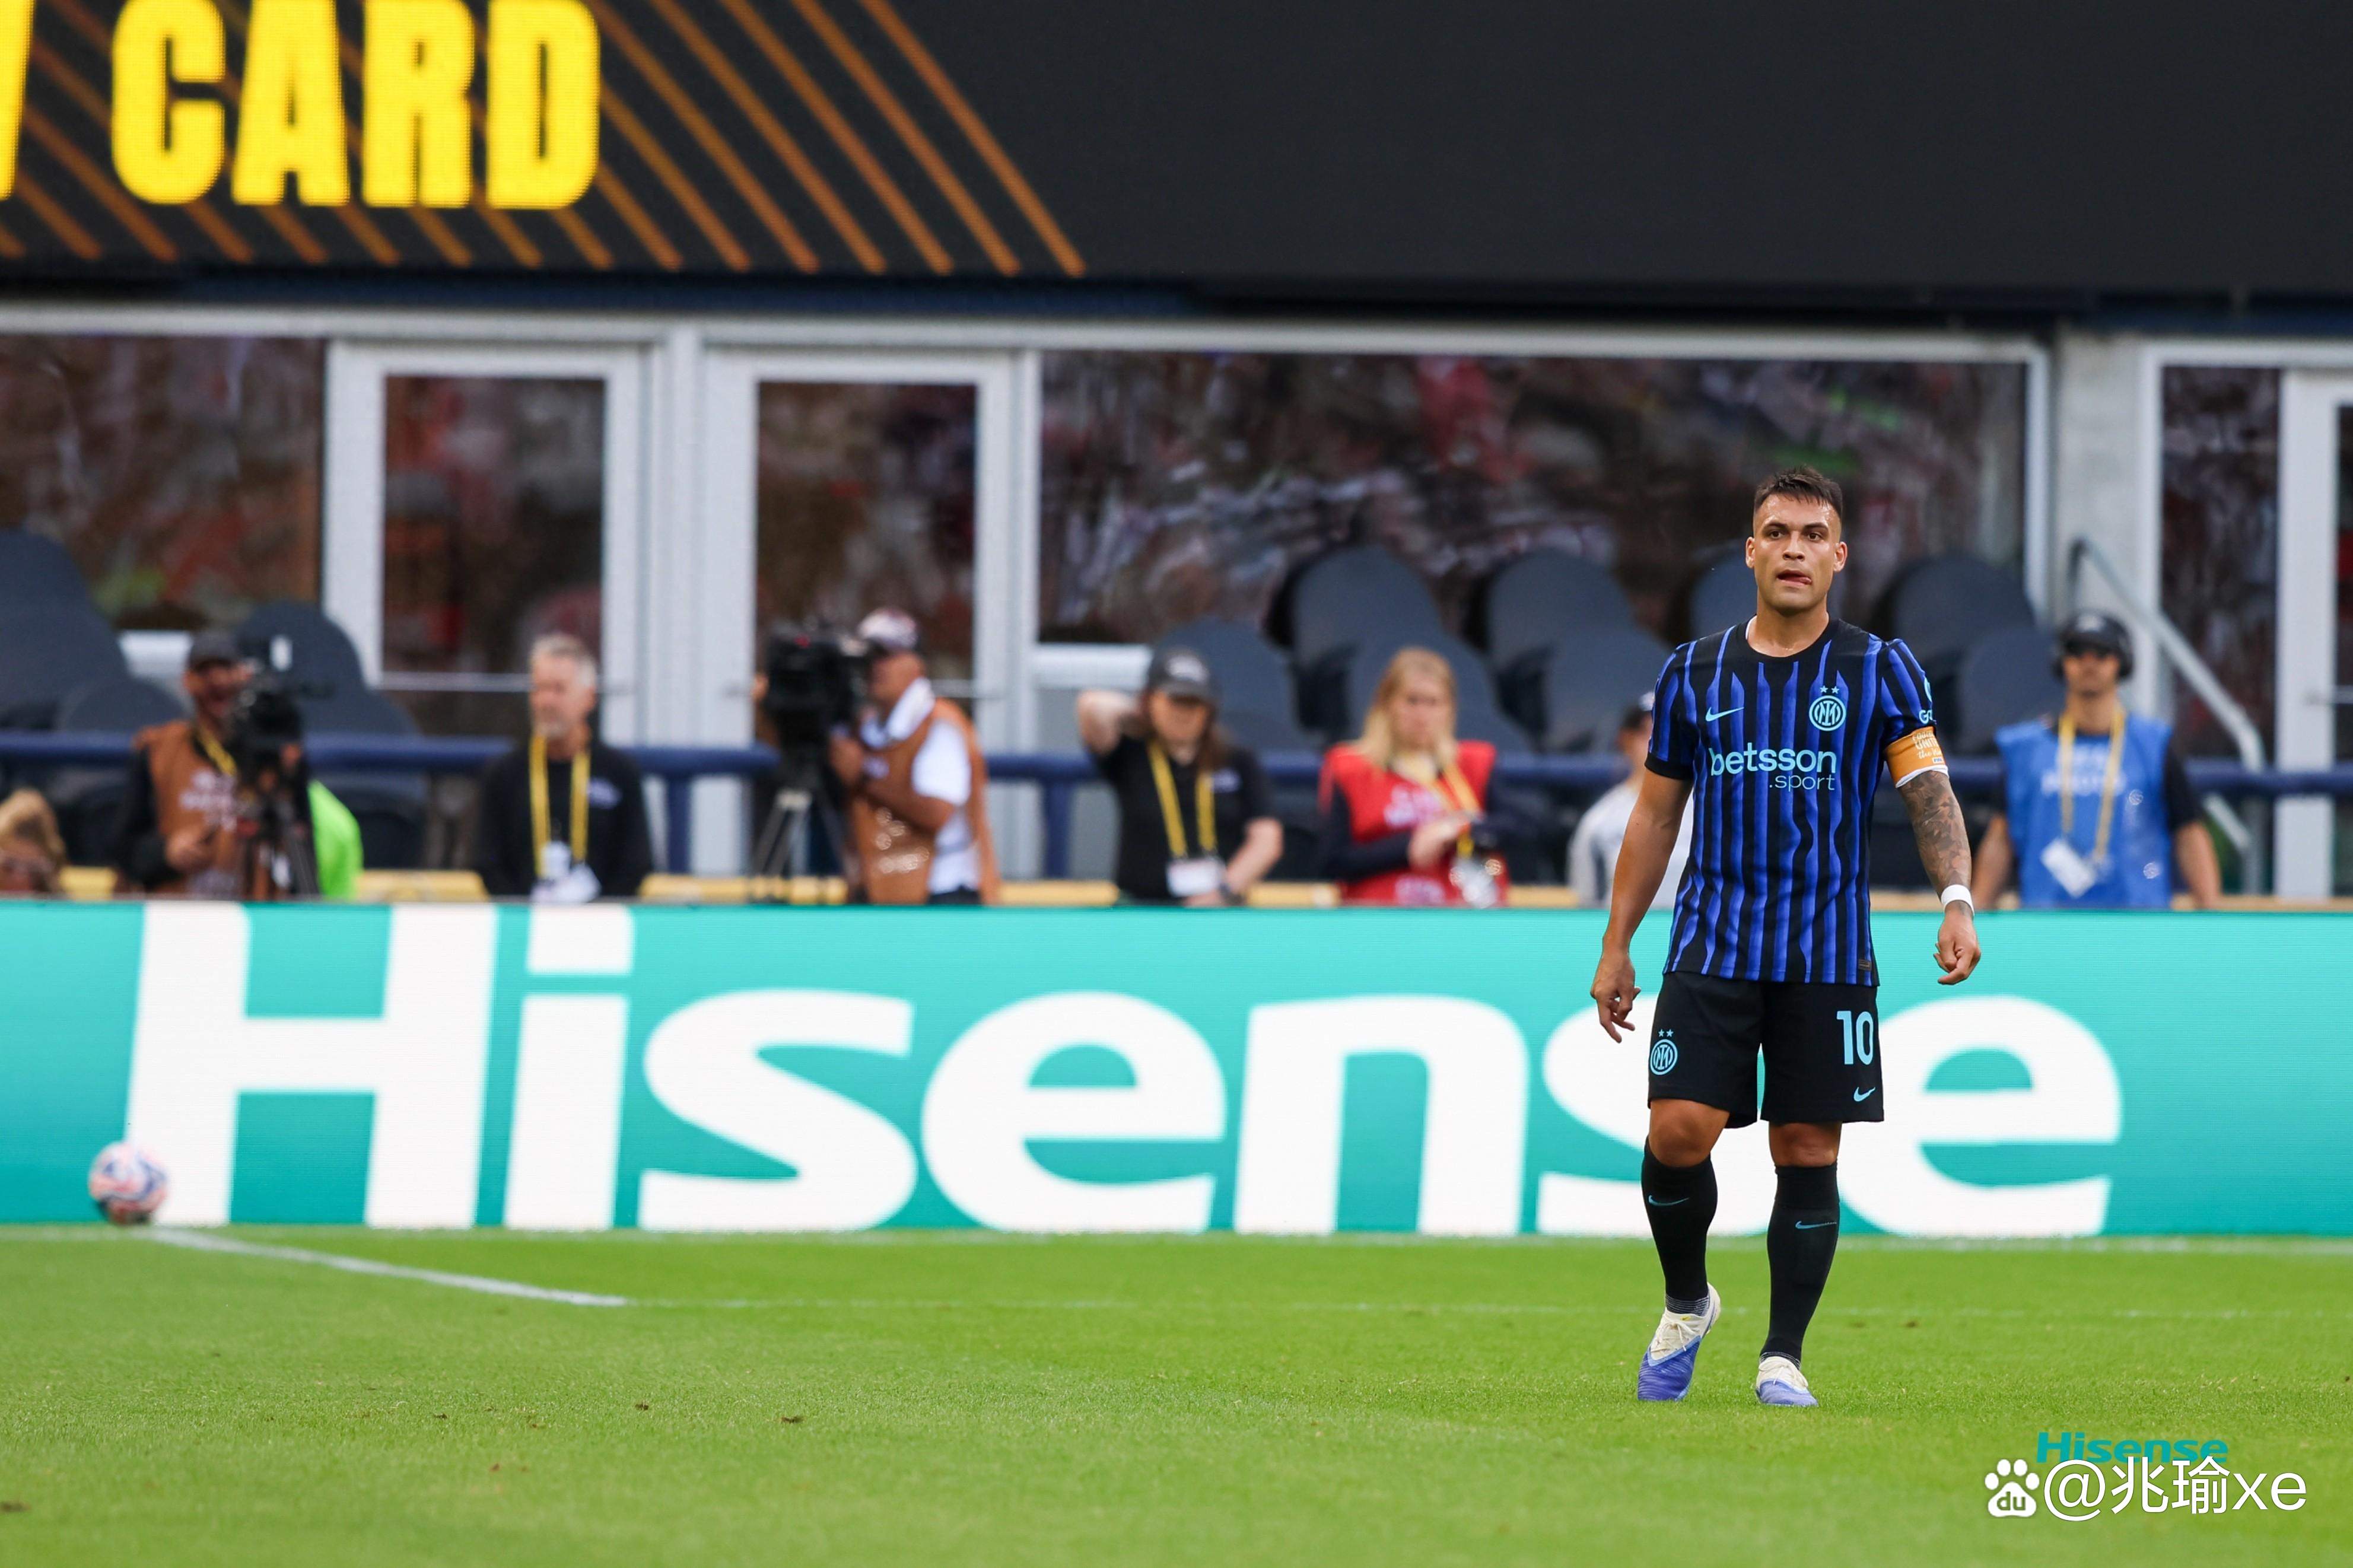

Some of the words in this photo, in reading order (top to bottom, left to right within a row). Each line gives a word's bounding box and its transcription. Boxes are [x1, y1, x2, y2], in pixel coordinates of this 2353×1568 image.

[112, 0, 600, 209] CARD
[1708, 742, 1836, 776] betsson
[123, 903, 2120, 1236] Hisense
[1837, 1010, 1874, 1065] 10
